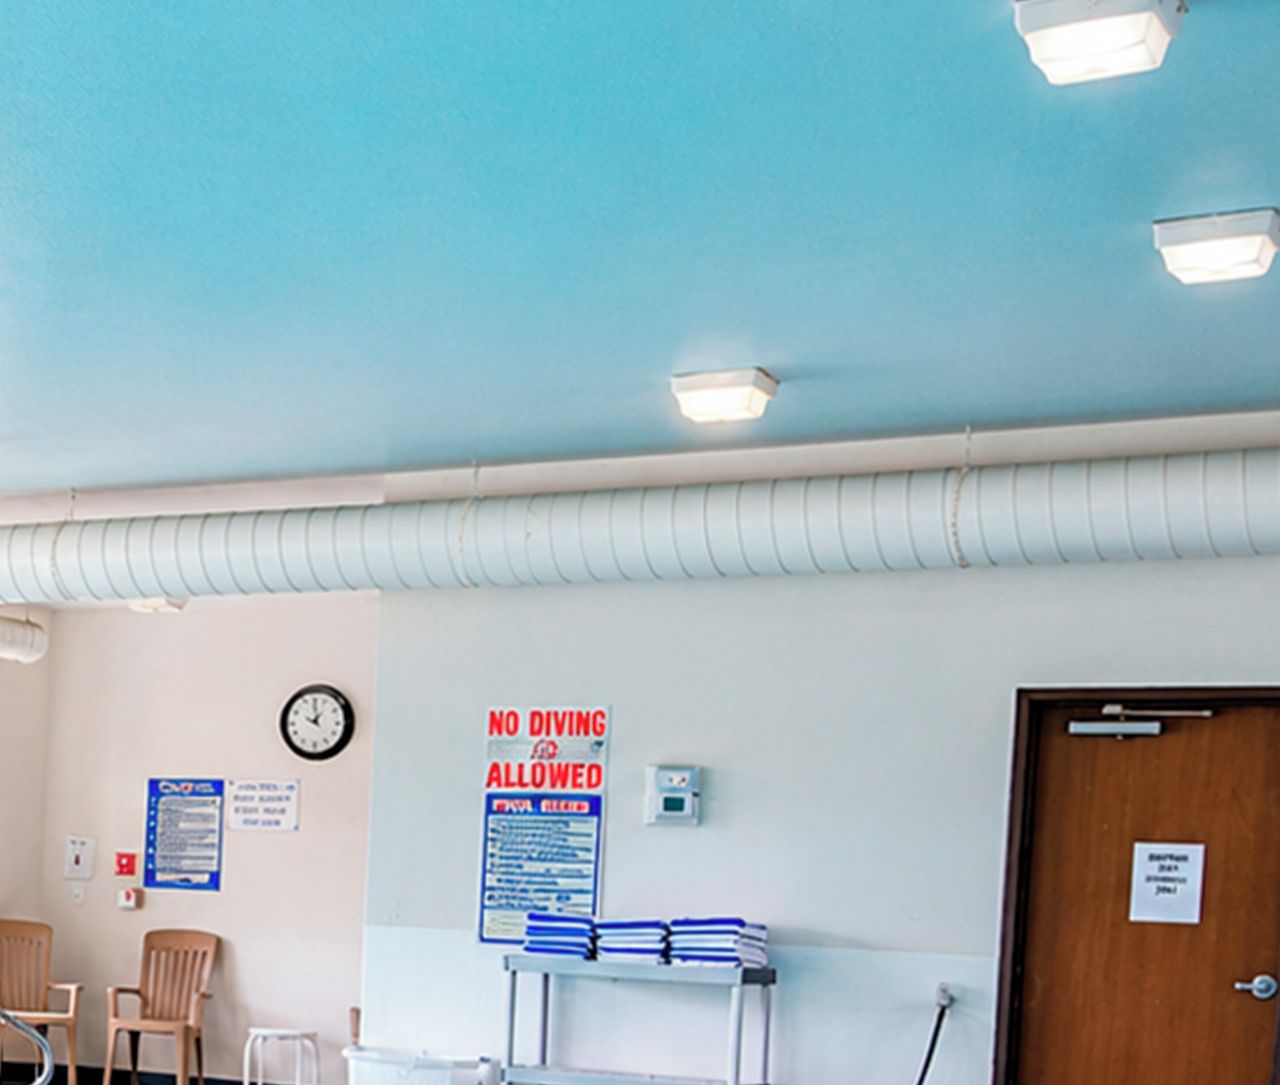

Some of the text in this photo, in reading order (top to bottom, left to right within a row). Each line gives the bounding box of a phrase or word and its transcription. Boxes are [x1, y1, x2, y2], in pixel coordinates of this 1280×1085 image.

[489, 710, 606, 736] NO DIVING
[486, 762, 603, 789] ALLOWED
